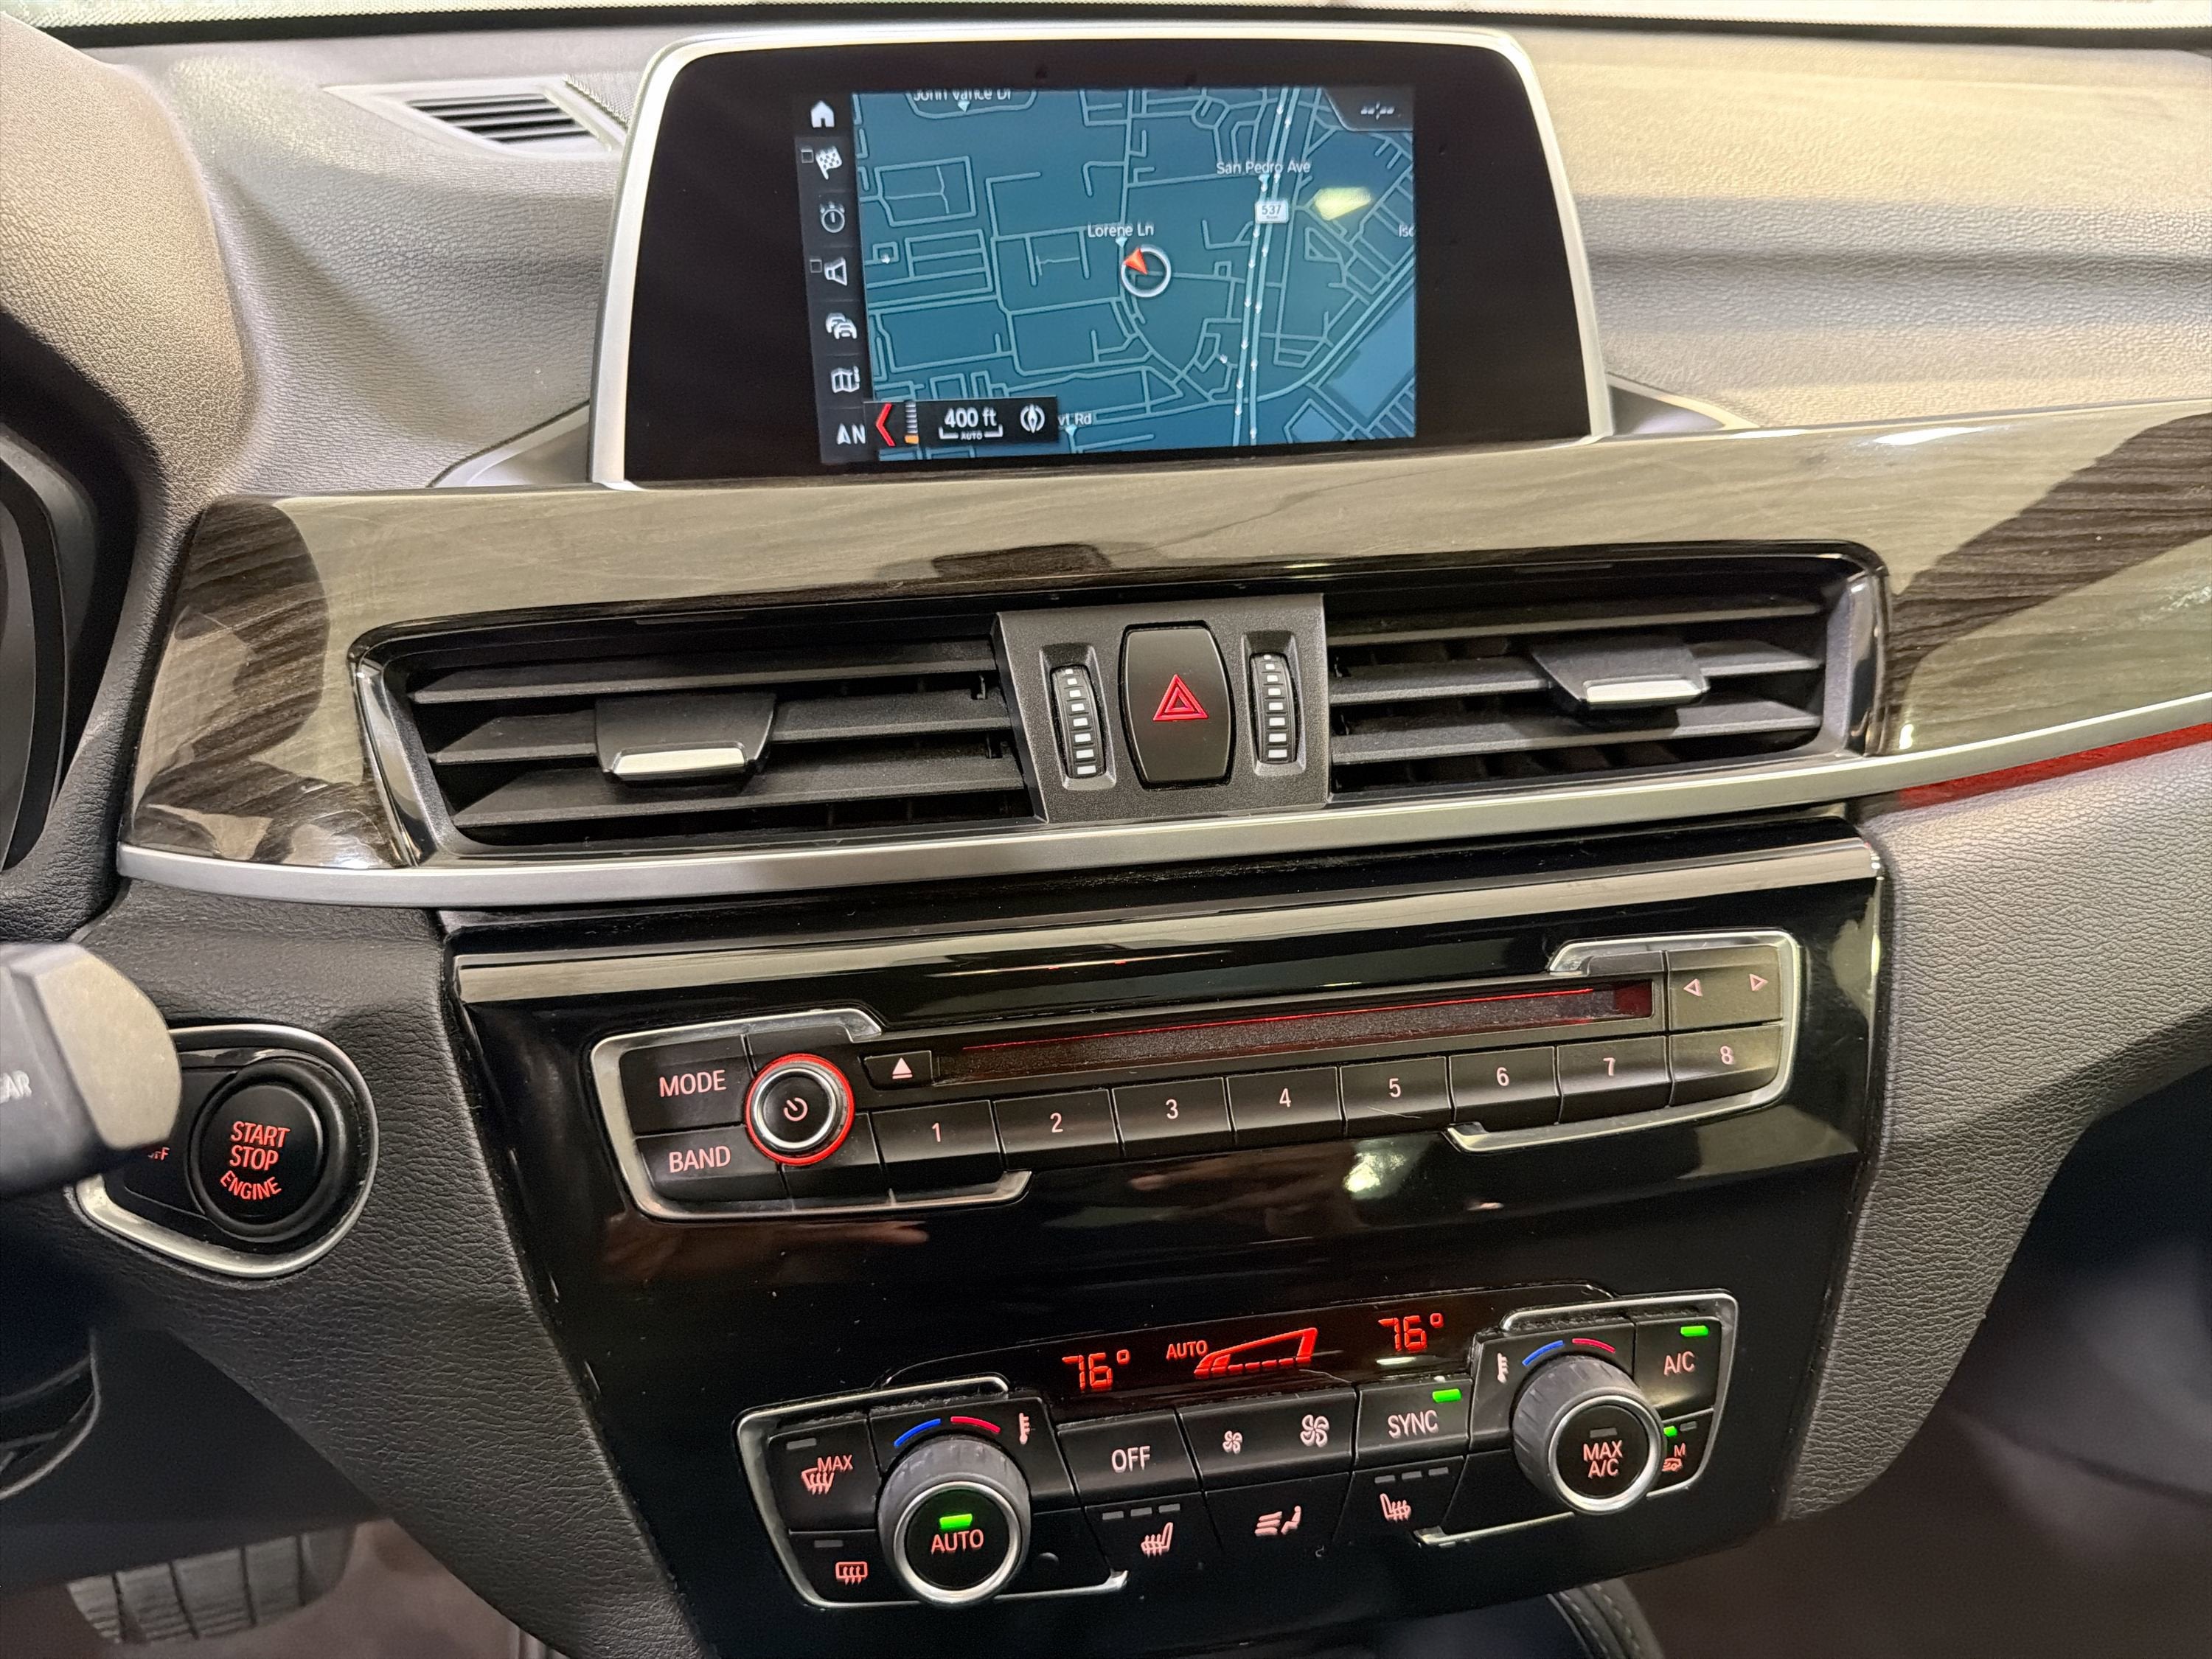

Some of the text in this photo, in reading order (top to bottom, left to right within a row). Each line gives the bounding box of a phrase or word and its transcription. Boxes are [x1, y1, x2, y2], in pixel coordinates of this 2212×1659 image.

[1216, 159, 1312, 175] San Pedro Ave
[1262, 204, 1281, 215] 537
[1087, 223, 1155, 238] Lorene Ln
[944, 406, 998, 428] 400 ft
[1074, 412, 1092, 425] Rd
[960, 431, 983, 441] AUTO
[1719, 1046, 1733, 1065] 8
[1496, 1067, 1509, 1087] 6
[1603, 1057, 1616, 1077] 7
[658, 1069, 727, 1097] MODE
[1388, 1078, 1402, 1098] 5
[1279, 1088, 1292, 1107] 4
[1165, 1099, 1179, 1119] 3
[931, 1122, 942, 1143] 1
[1050, 1113, 1063, 1133] 2
[231, 1120, 291, 1148] START
[229, 1144, 279, 1171] STOP
[668, 1146, 731, 1174] BAND
[220, 1170, 282, 1200] ENGINE
[1166, 1340, 1208, 1361] AUTO
[1663, 1350, 1696, 1377] A/C
[1387, 1409, 1439, 1439] SYNC
[1111, 1445, 1151, 1473] OFF
[1582, 1439, 1623, 1464] MAX
[1674, 1442, 1687, 1458] M
[817, 1454, 853, 1473] MAX
[1587, 1458, 1620, 1480] A/C
[931, 1528, 984, 1554] AUTO
